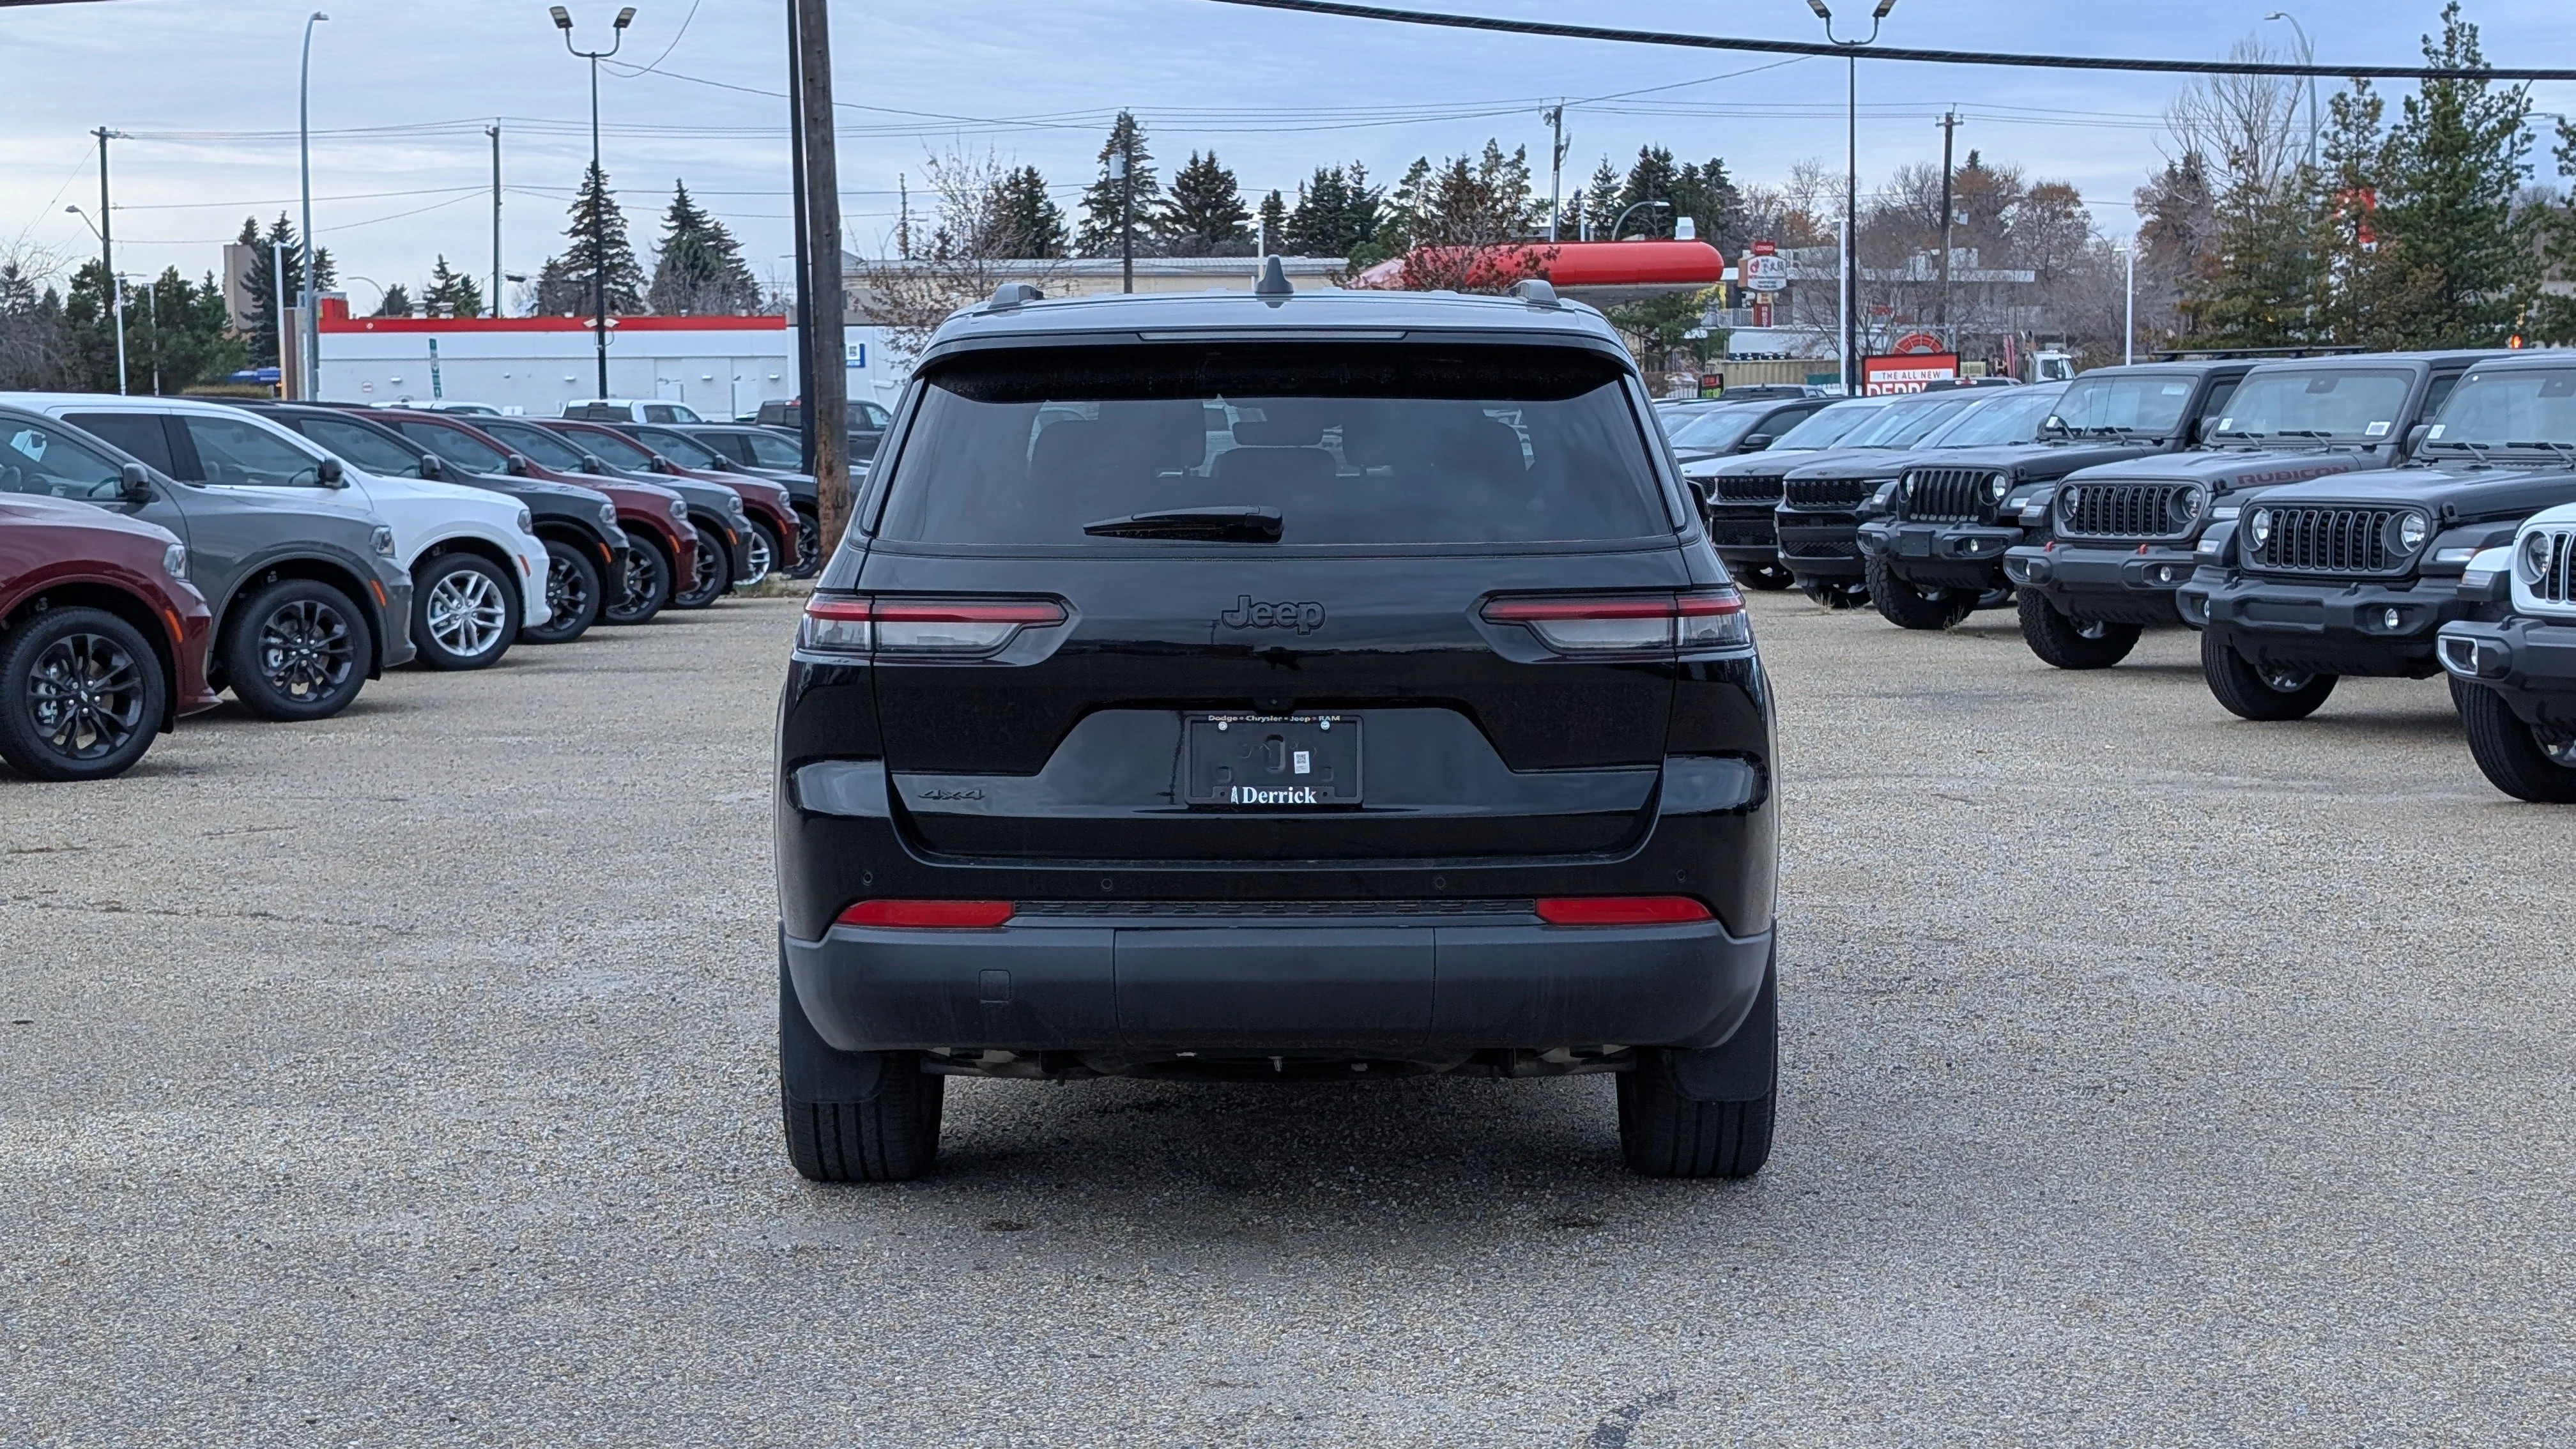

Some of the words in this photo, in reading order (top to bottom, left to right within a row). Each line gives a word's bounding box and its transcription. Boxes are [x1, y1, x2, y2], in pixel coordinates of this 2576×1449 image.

[1882, 371, 1897, 380] THE
[1901, 371, 1917, 379] ALL
[1920, 371, 1941, 379] NEW
[2237, 466, 2350, 485] RUBICON
[1221, 594, 1326, 636] Jeep
[917, 788, 985, 800] 4x4
[1241, 786, 1317, 804] Derrick
